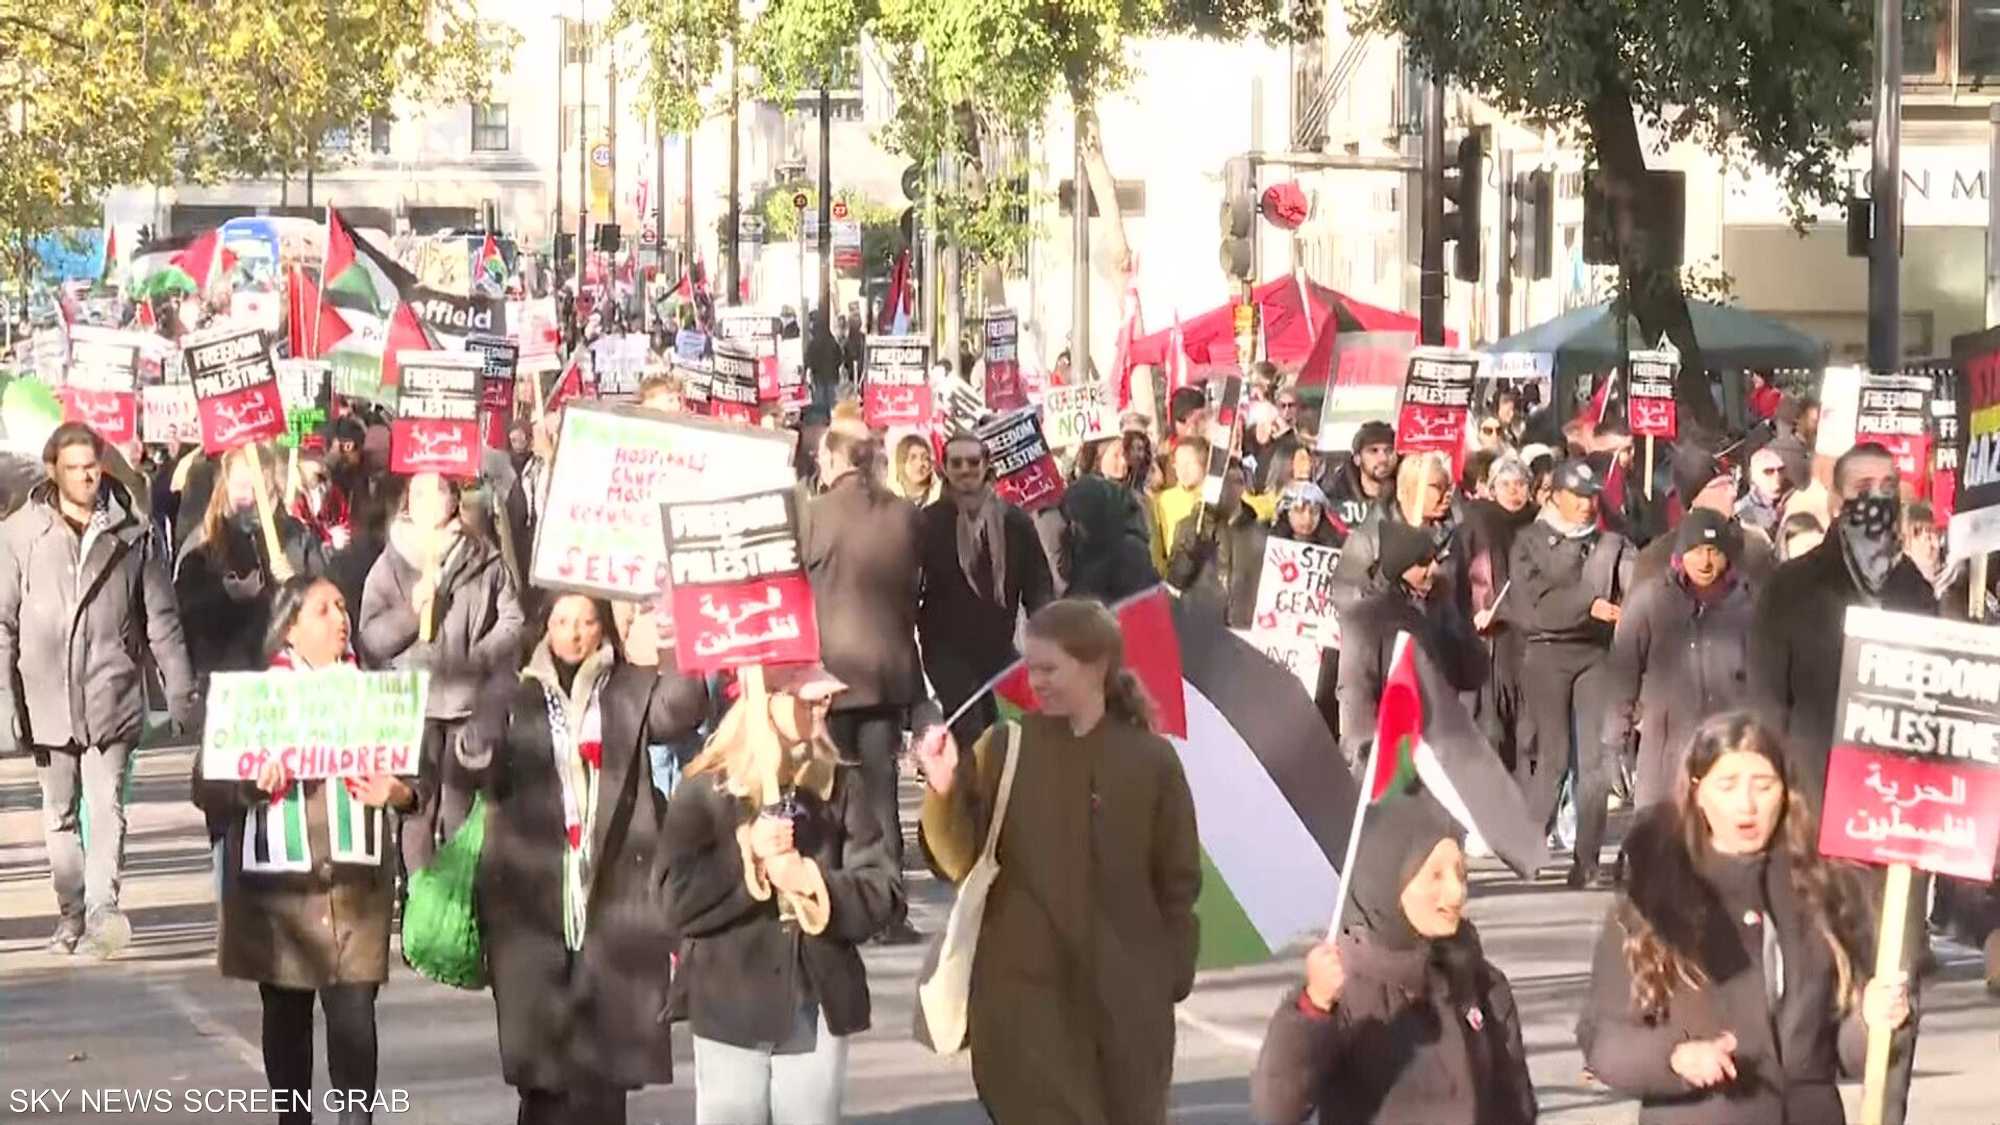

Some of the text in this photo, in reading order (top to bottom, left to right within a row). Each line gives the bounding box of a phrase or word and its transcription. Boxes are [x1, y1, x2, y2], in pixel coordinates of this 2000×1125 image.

[193, 334, 262, 371] FREEDOM
[870, 348, 923, 365] FREEDOM
[195, 361, 271, 400] PALESTINE
[1406, 385, 1471, 406] PALESTINE
[670, 494, 788, 539] FREEDOM
[671, 539, 800, 585] PALESTINE
[1857, 643, 2000, 704] FREEDOM
[1843, 700, 2000, 764] PALESTINE
[280, 745, 410, 776] CHILDREN
[1863, 761, 1967, 808] الحرية
[1845, 804, 1978, 850] لفلسطين
